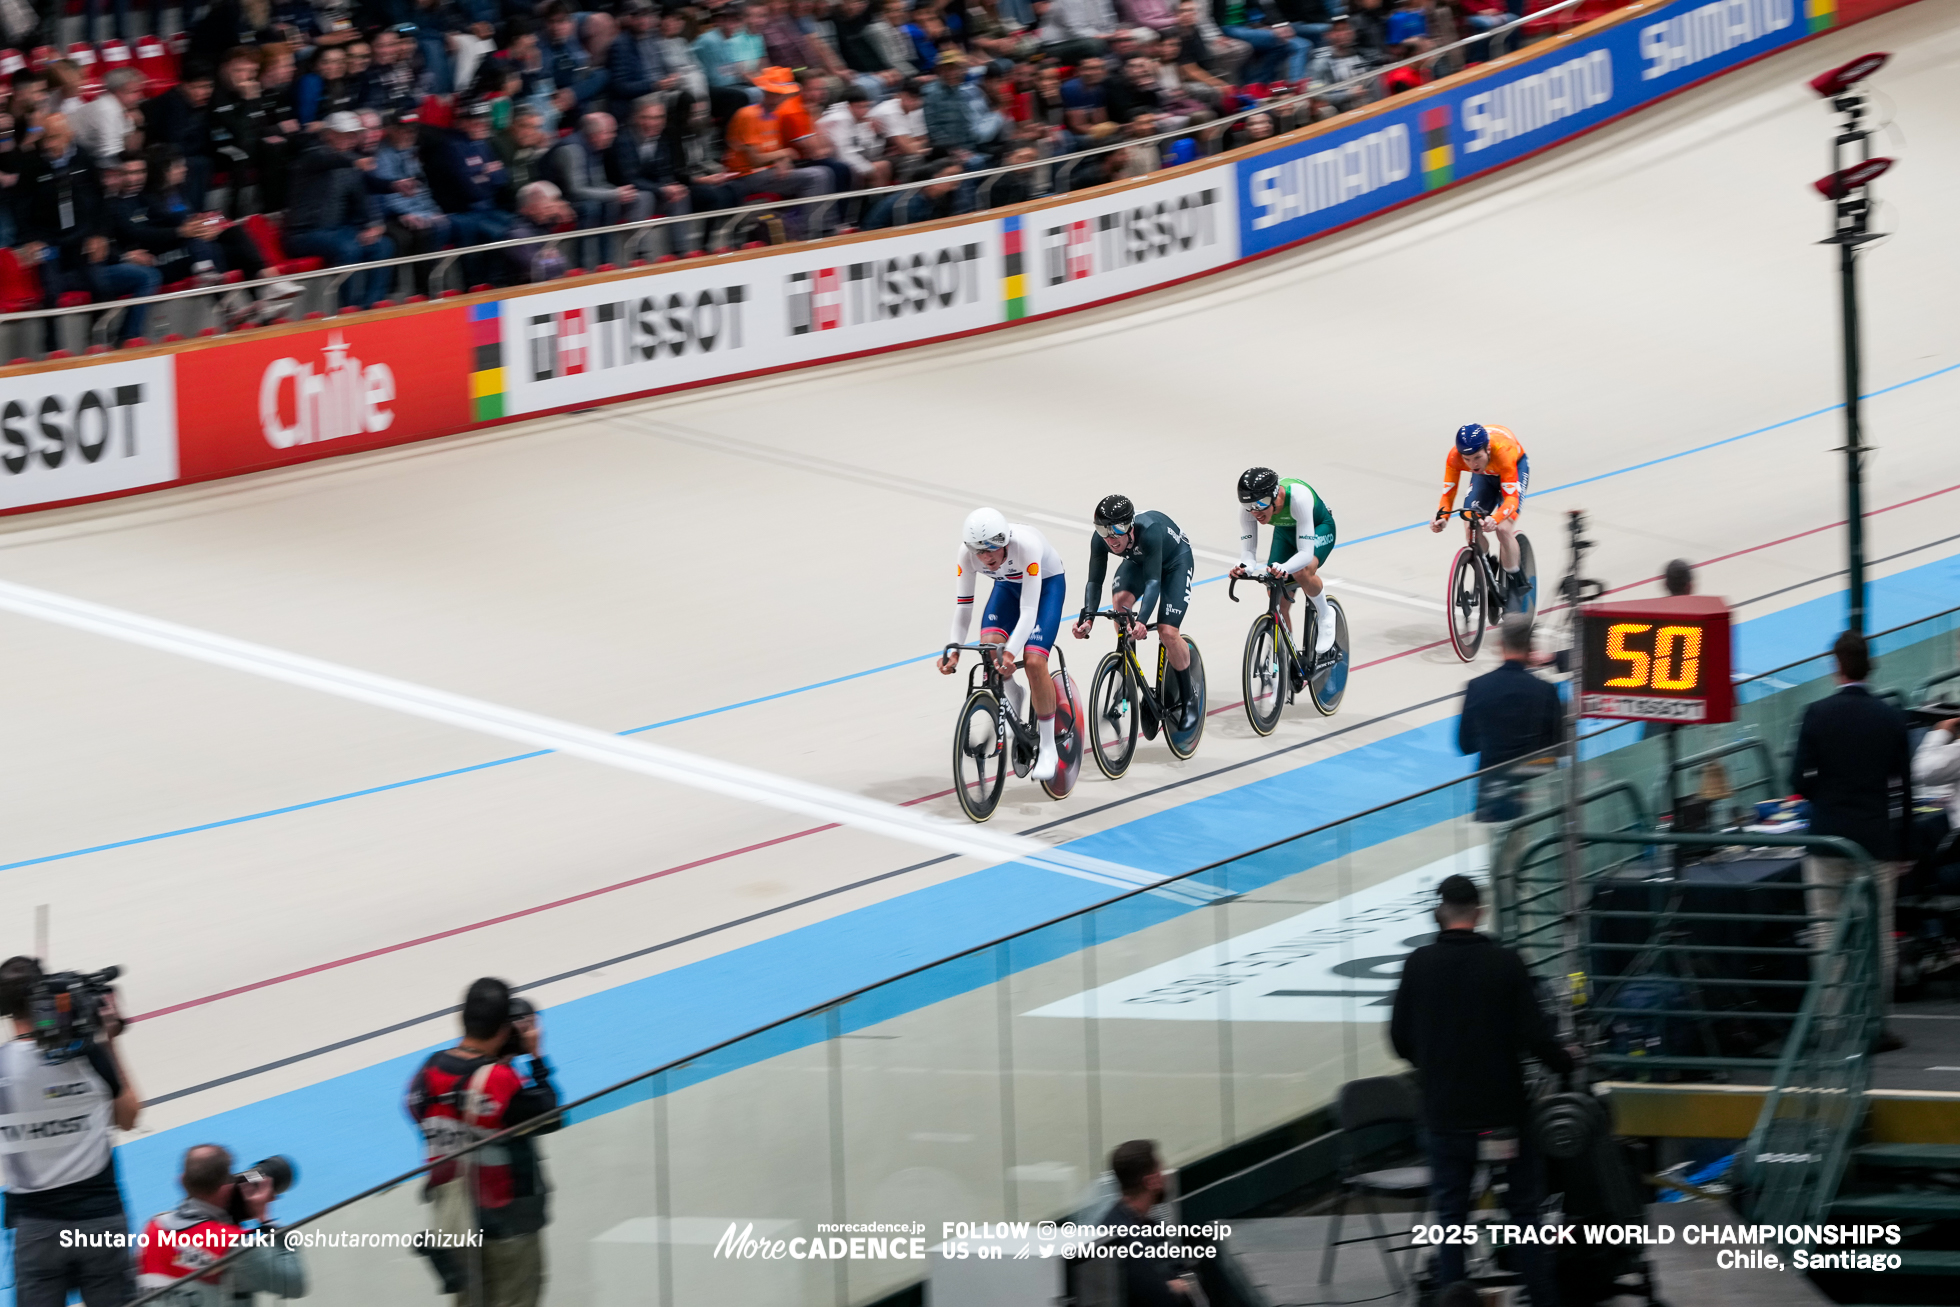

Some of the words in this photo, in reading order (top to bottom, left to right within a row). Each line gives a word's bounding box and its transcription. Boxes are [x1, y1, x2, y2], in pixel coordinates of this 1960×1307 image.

[1461, 48, 1613, 154] SHIMANO
[1250, 123, 1411, 231] SHIMANO
[1096, 187, 1221, 272] TISSOT
[845, 242, 985, 325] TISSOT
[591, 284, 749, 370] TISSOT
[258, 335, 396, 449] Chile
[1604, 624, 1703, 690] 50
[997, 698, 1007, 742] LOTUS
